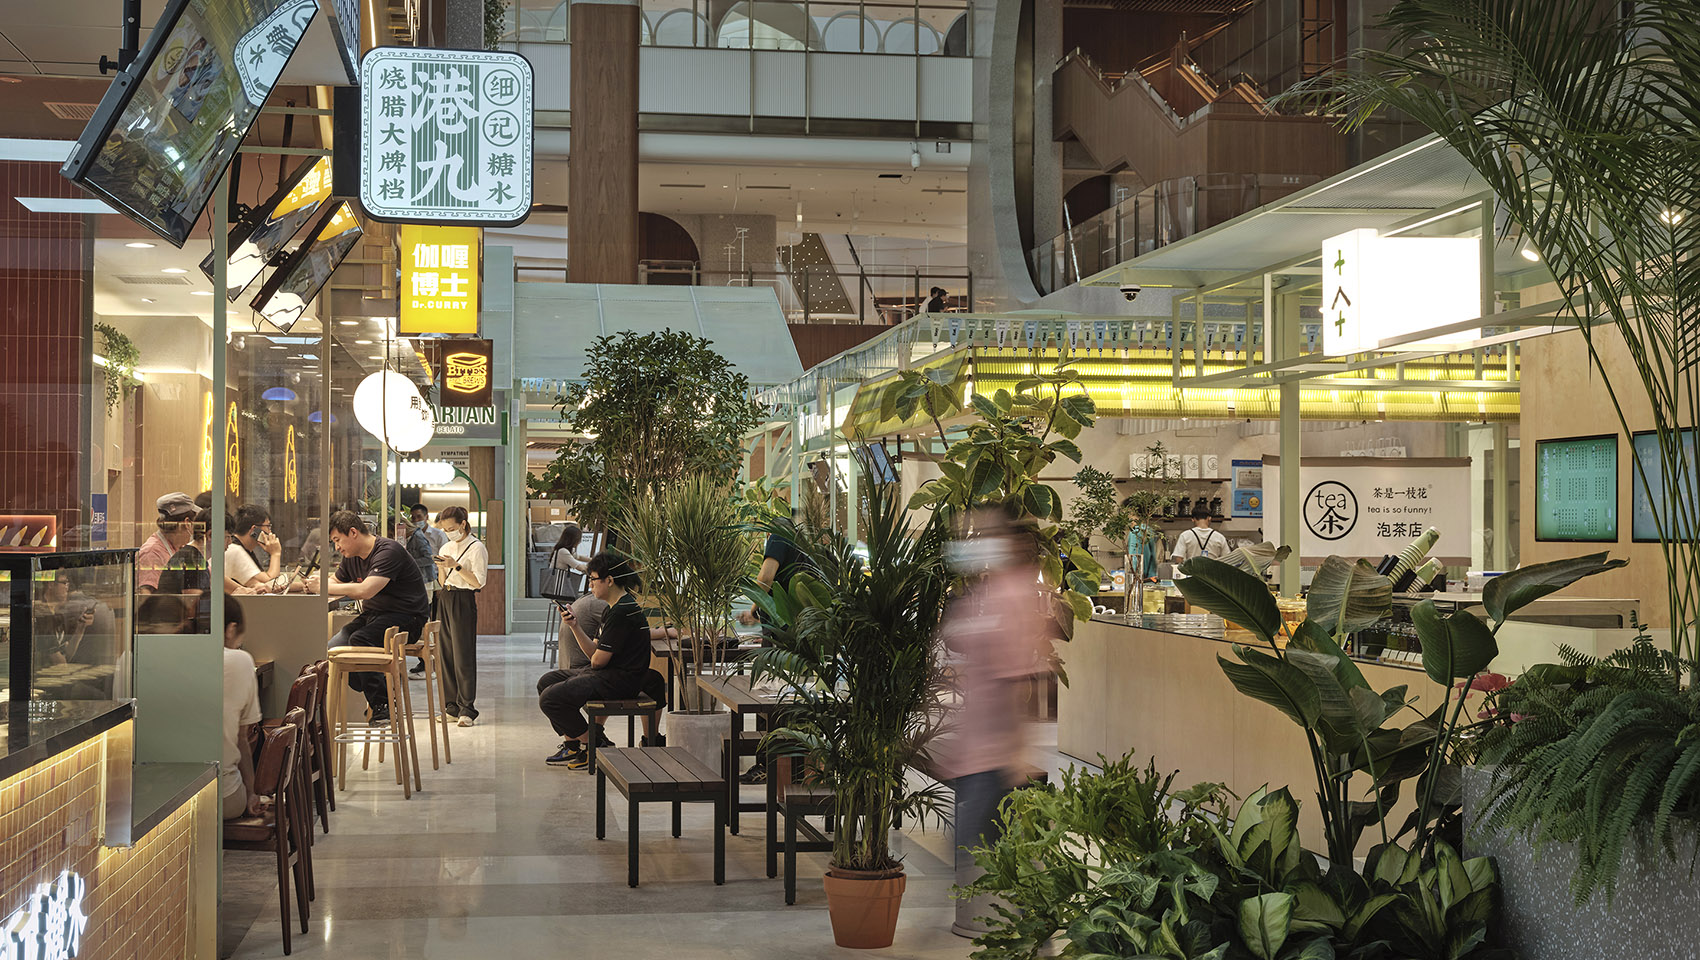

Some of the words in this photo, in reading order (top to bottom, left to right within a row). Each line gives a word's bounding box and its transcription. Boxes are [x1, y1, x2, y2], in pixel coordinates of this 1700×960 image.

[377, 66, 408, 201] 烧腊大牌档
[411, 67, 480, 202] 港九
[412, 243, 469, 268] 伽喱
[411, 272, 468, 297] 博士
[447, 365, 487, 376] BITES
[1314, 490, 1347, 509] tea
[1372, 487, 1428, 499] 茶是一枝花
[1313, 506, 1350, 534] 茶
[1367, 506, 1380, 514] tea
[1383, 506, 1390, 514] is
[1404, 506, 1432, 515] funny!
[1376, 522, 1422, 538] 泡茶店
